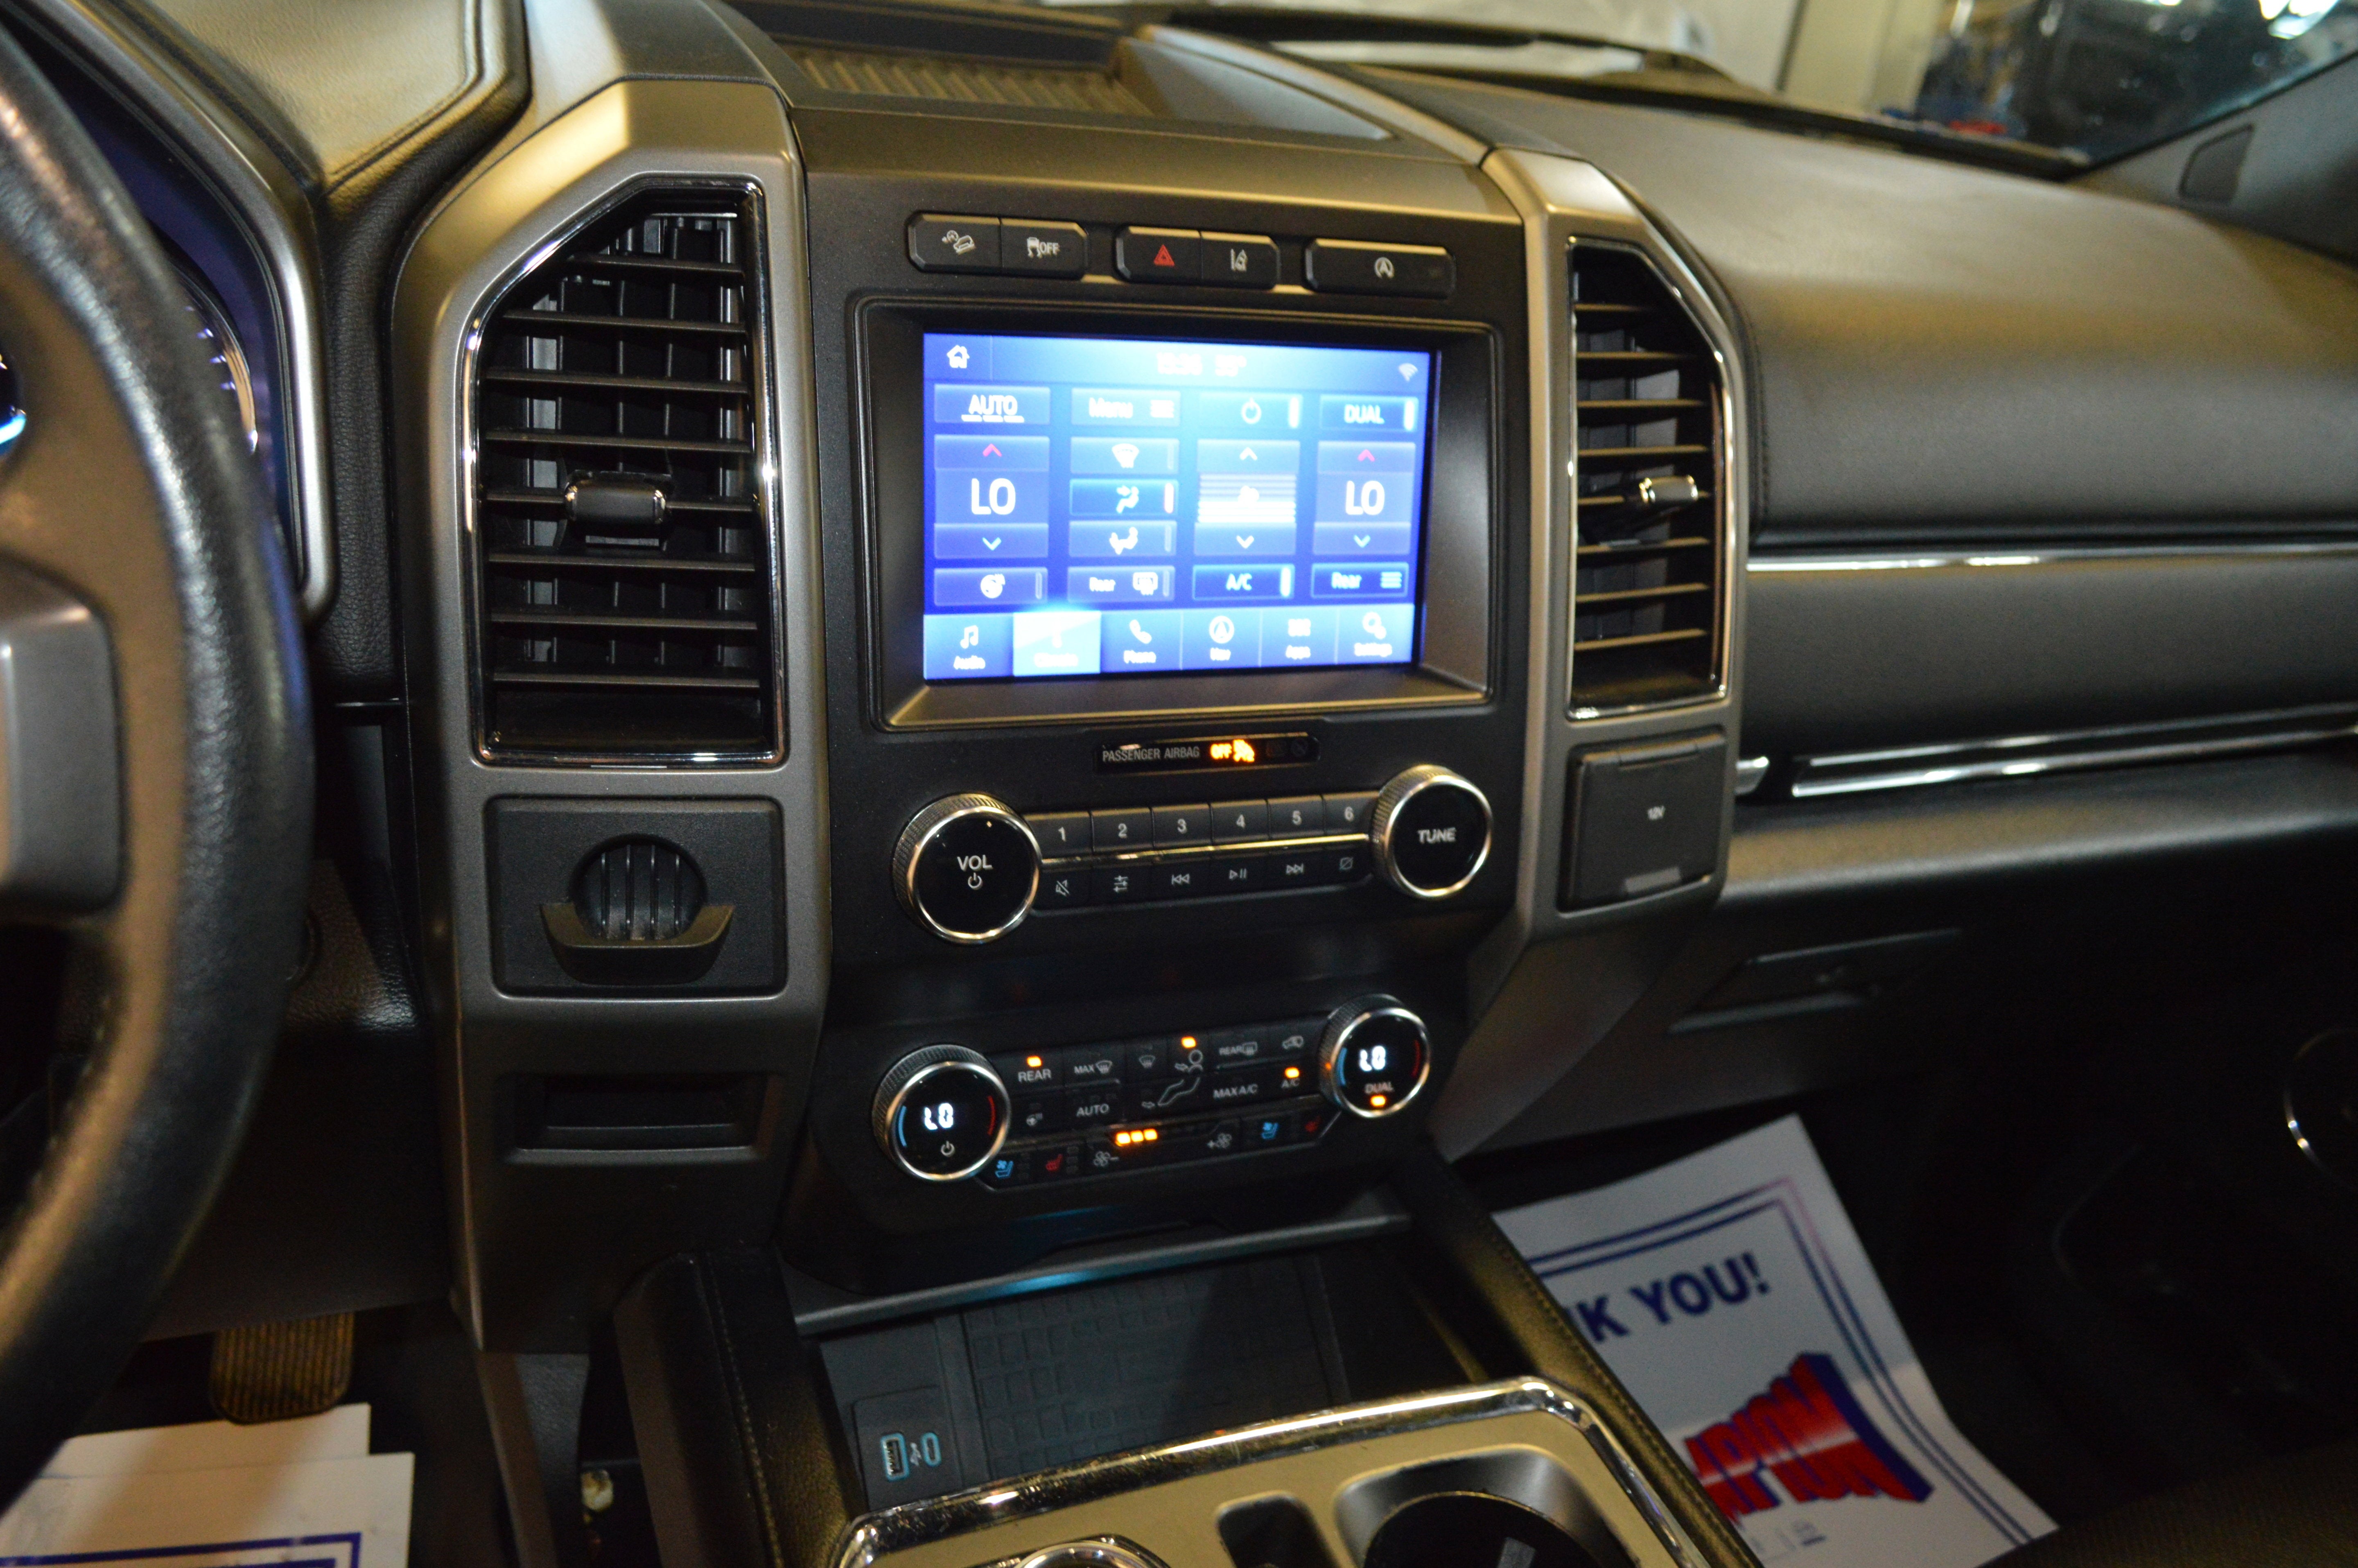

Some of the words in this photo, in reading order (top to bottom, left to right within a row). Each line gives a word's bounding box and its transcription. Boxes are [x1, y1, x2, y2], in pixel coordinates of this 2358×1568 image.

[1040, 242, 1060, 255] OFF
[968, 394, 1018, 415] AUTO
[1344, 404, 1385, 424] DUAL
[971, 478, 1016, 515] LO
[1345, 480, 1385, 515] LO
[1226, 573, 1252, 590] A/C
[1331, 572, 1362, 589] Rear
[1102, 748, 1160, 762] PASSENGER
[1164, 746, 1200, 758] AIRBAG
[1236, 814, 1245, 828] 4
[1292, 810, 1301, 825] 5
[1344, 807, 1354, 821] 6
[1058, 827, 1066, 841] 1
[1118, 823, 1127, 838] 2
[1177, 819, 1187, 834] 3
[1417, 827, 1456, 844] TUNE
[957, 854, 992, 871] VOL
[1018, 1068, 1052, 1082] REAR
[1074, 1064, 1095, 1074] MAX
[1213, 1087, 1238, 1099] MAX
[1364, 1082, 1395, 1095] DUAL
[1076, 1103, 1110, 1117] AUTO
[1628, 1250, 1770, 1325] YOU!
